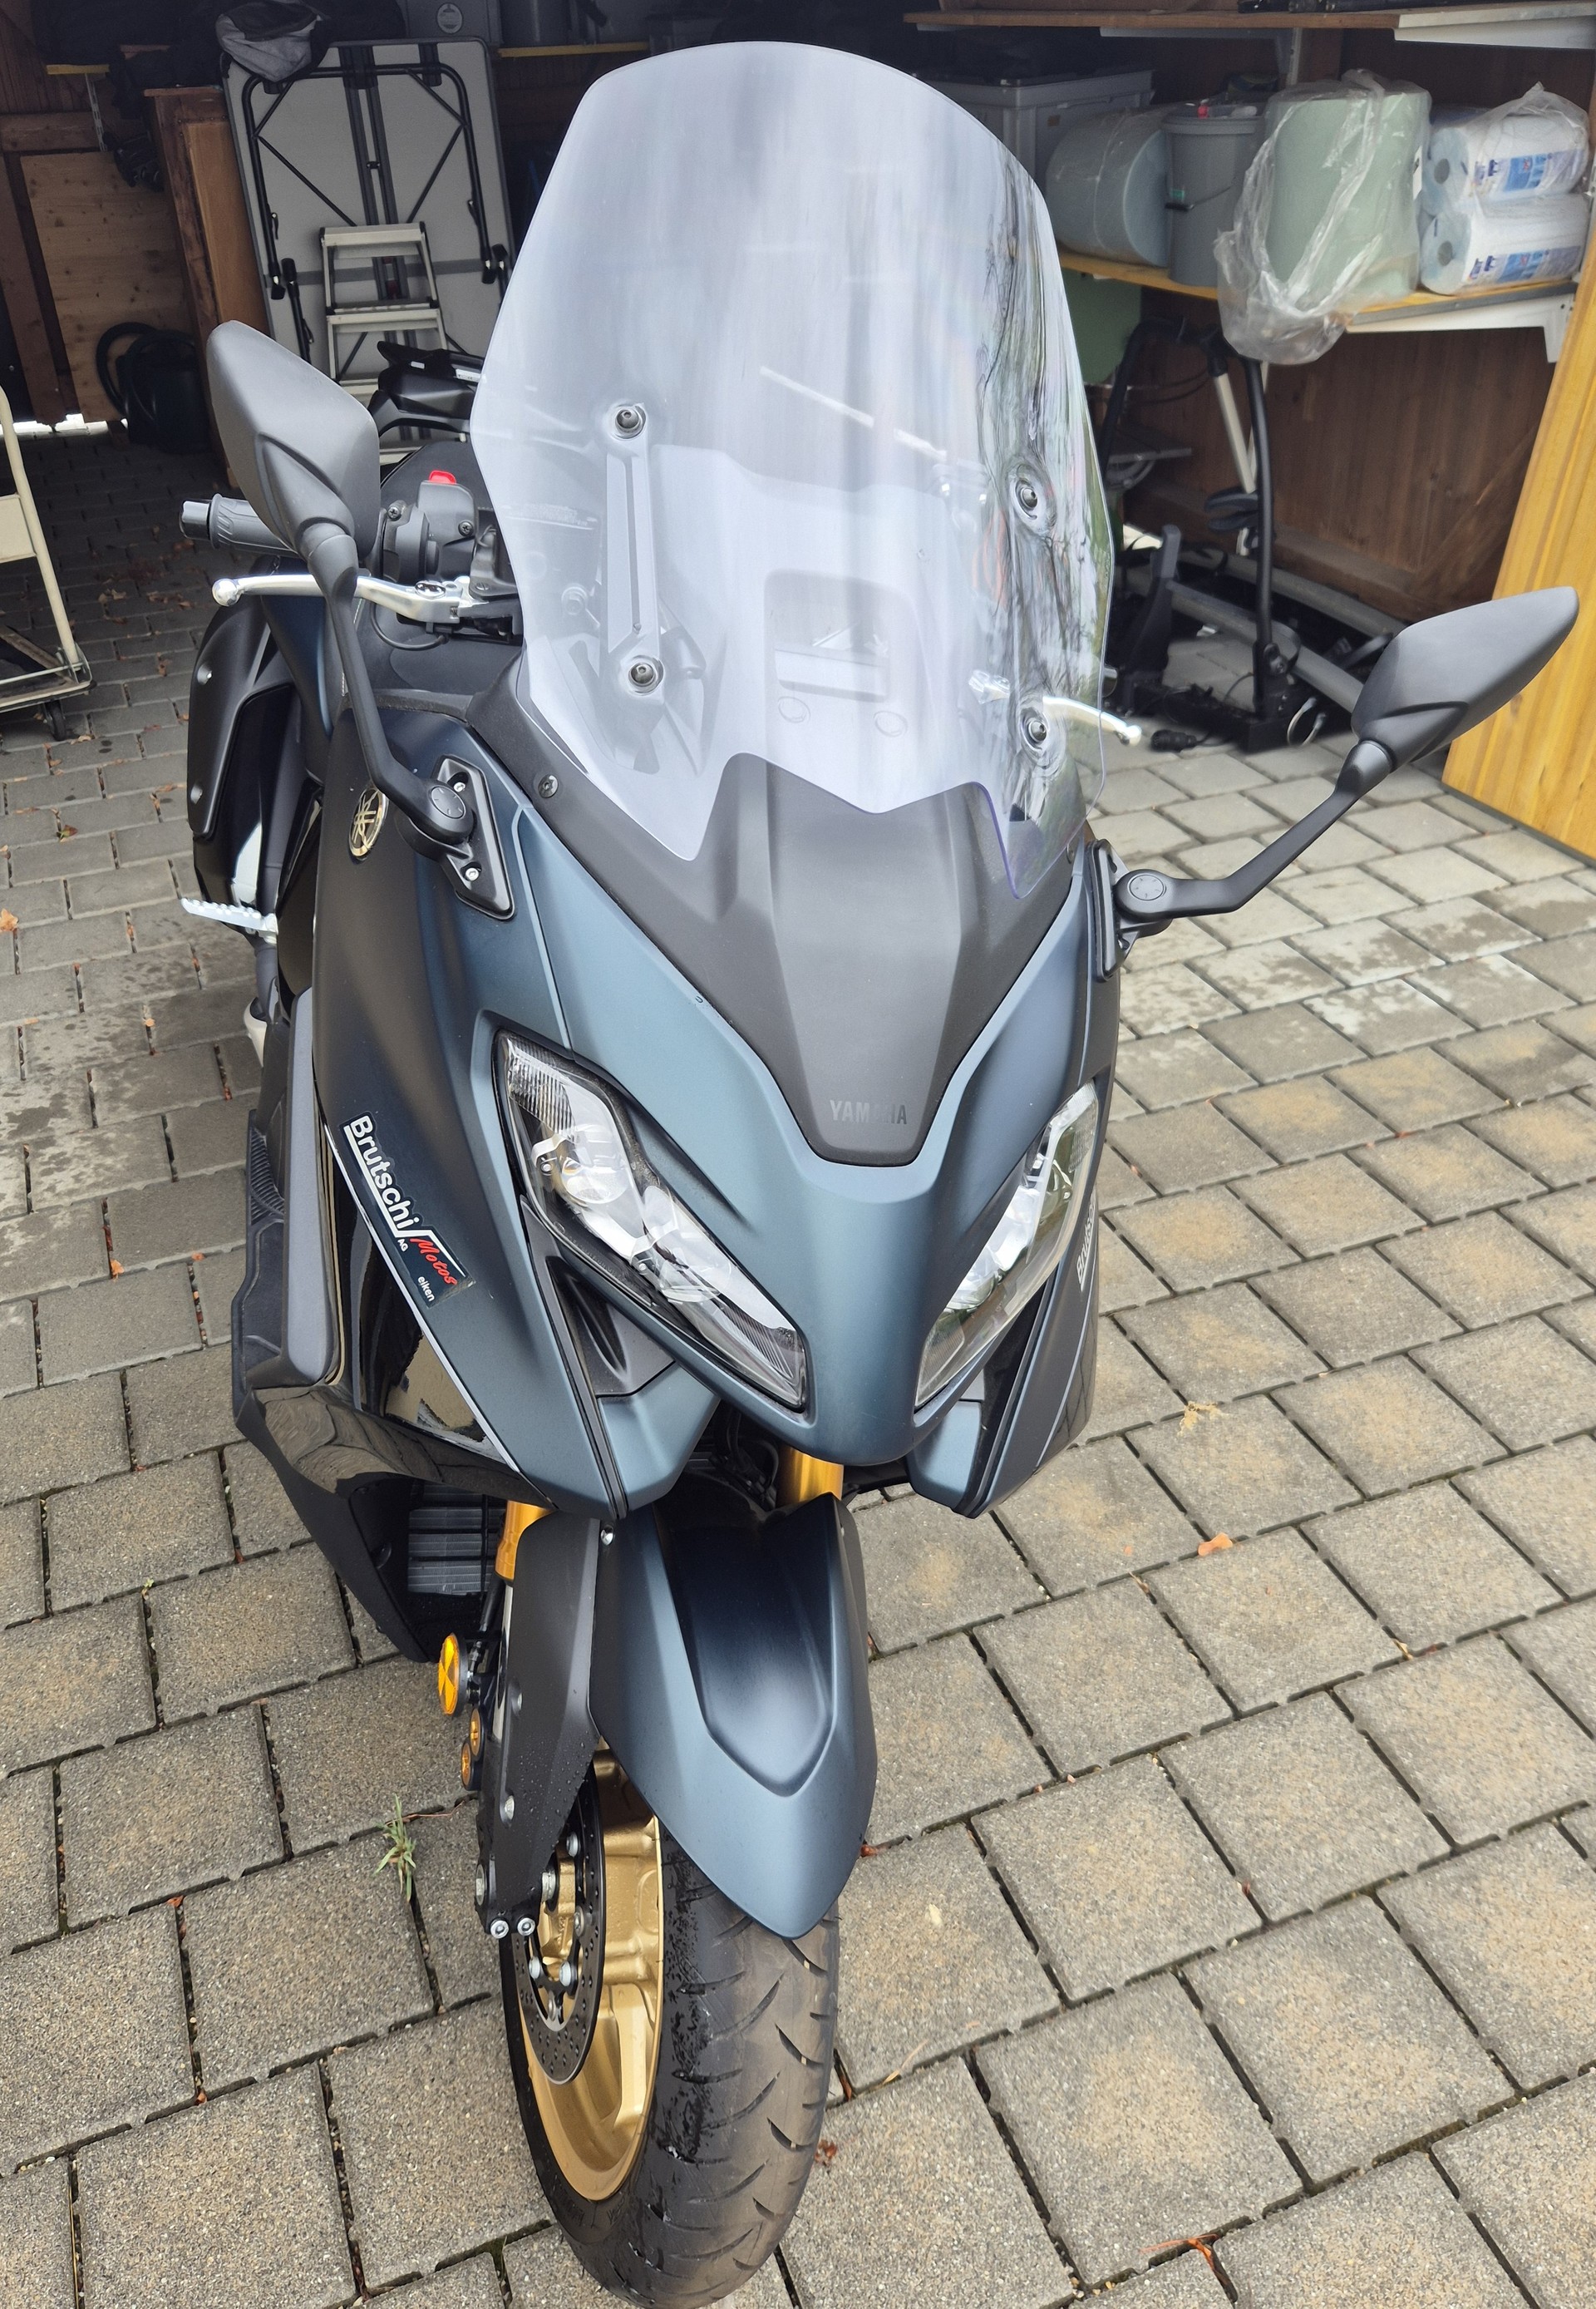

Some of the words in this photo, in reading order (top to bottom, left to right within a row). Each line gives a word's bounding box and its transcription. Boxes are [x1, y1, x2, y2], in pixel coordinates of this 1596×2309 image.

[830, 1099, 908, 1125] YAMHA
[350, 1115, 421, 1229] Brutschi
[397, 1238, 409, 1252] AG
[409, 1237, 458, 1286] Motos
